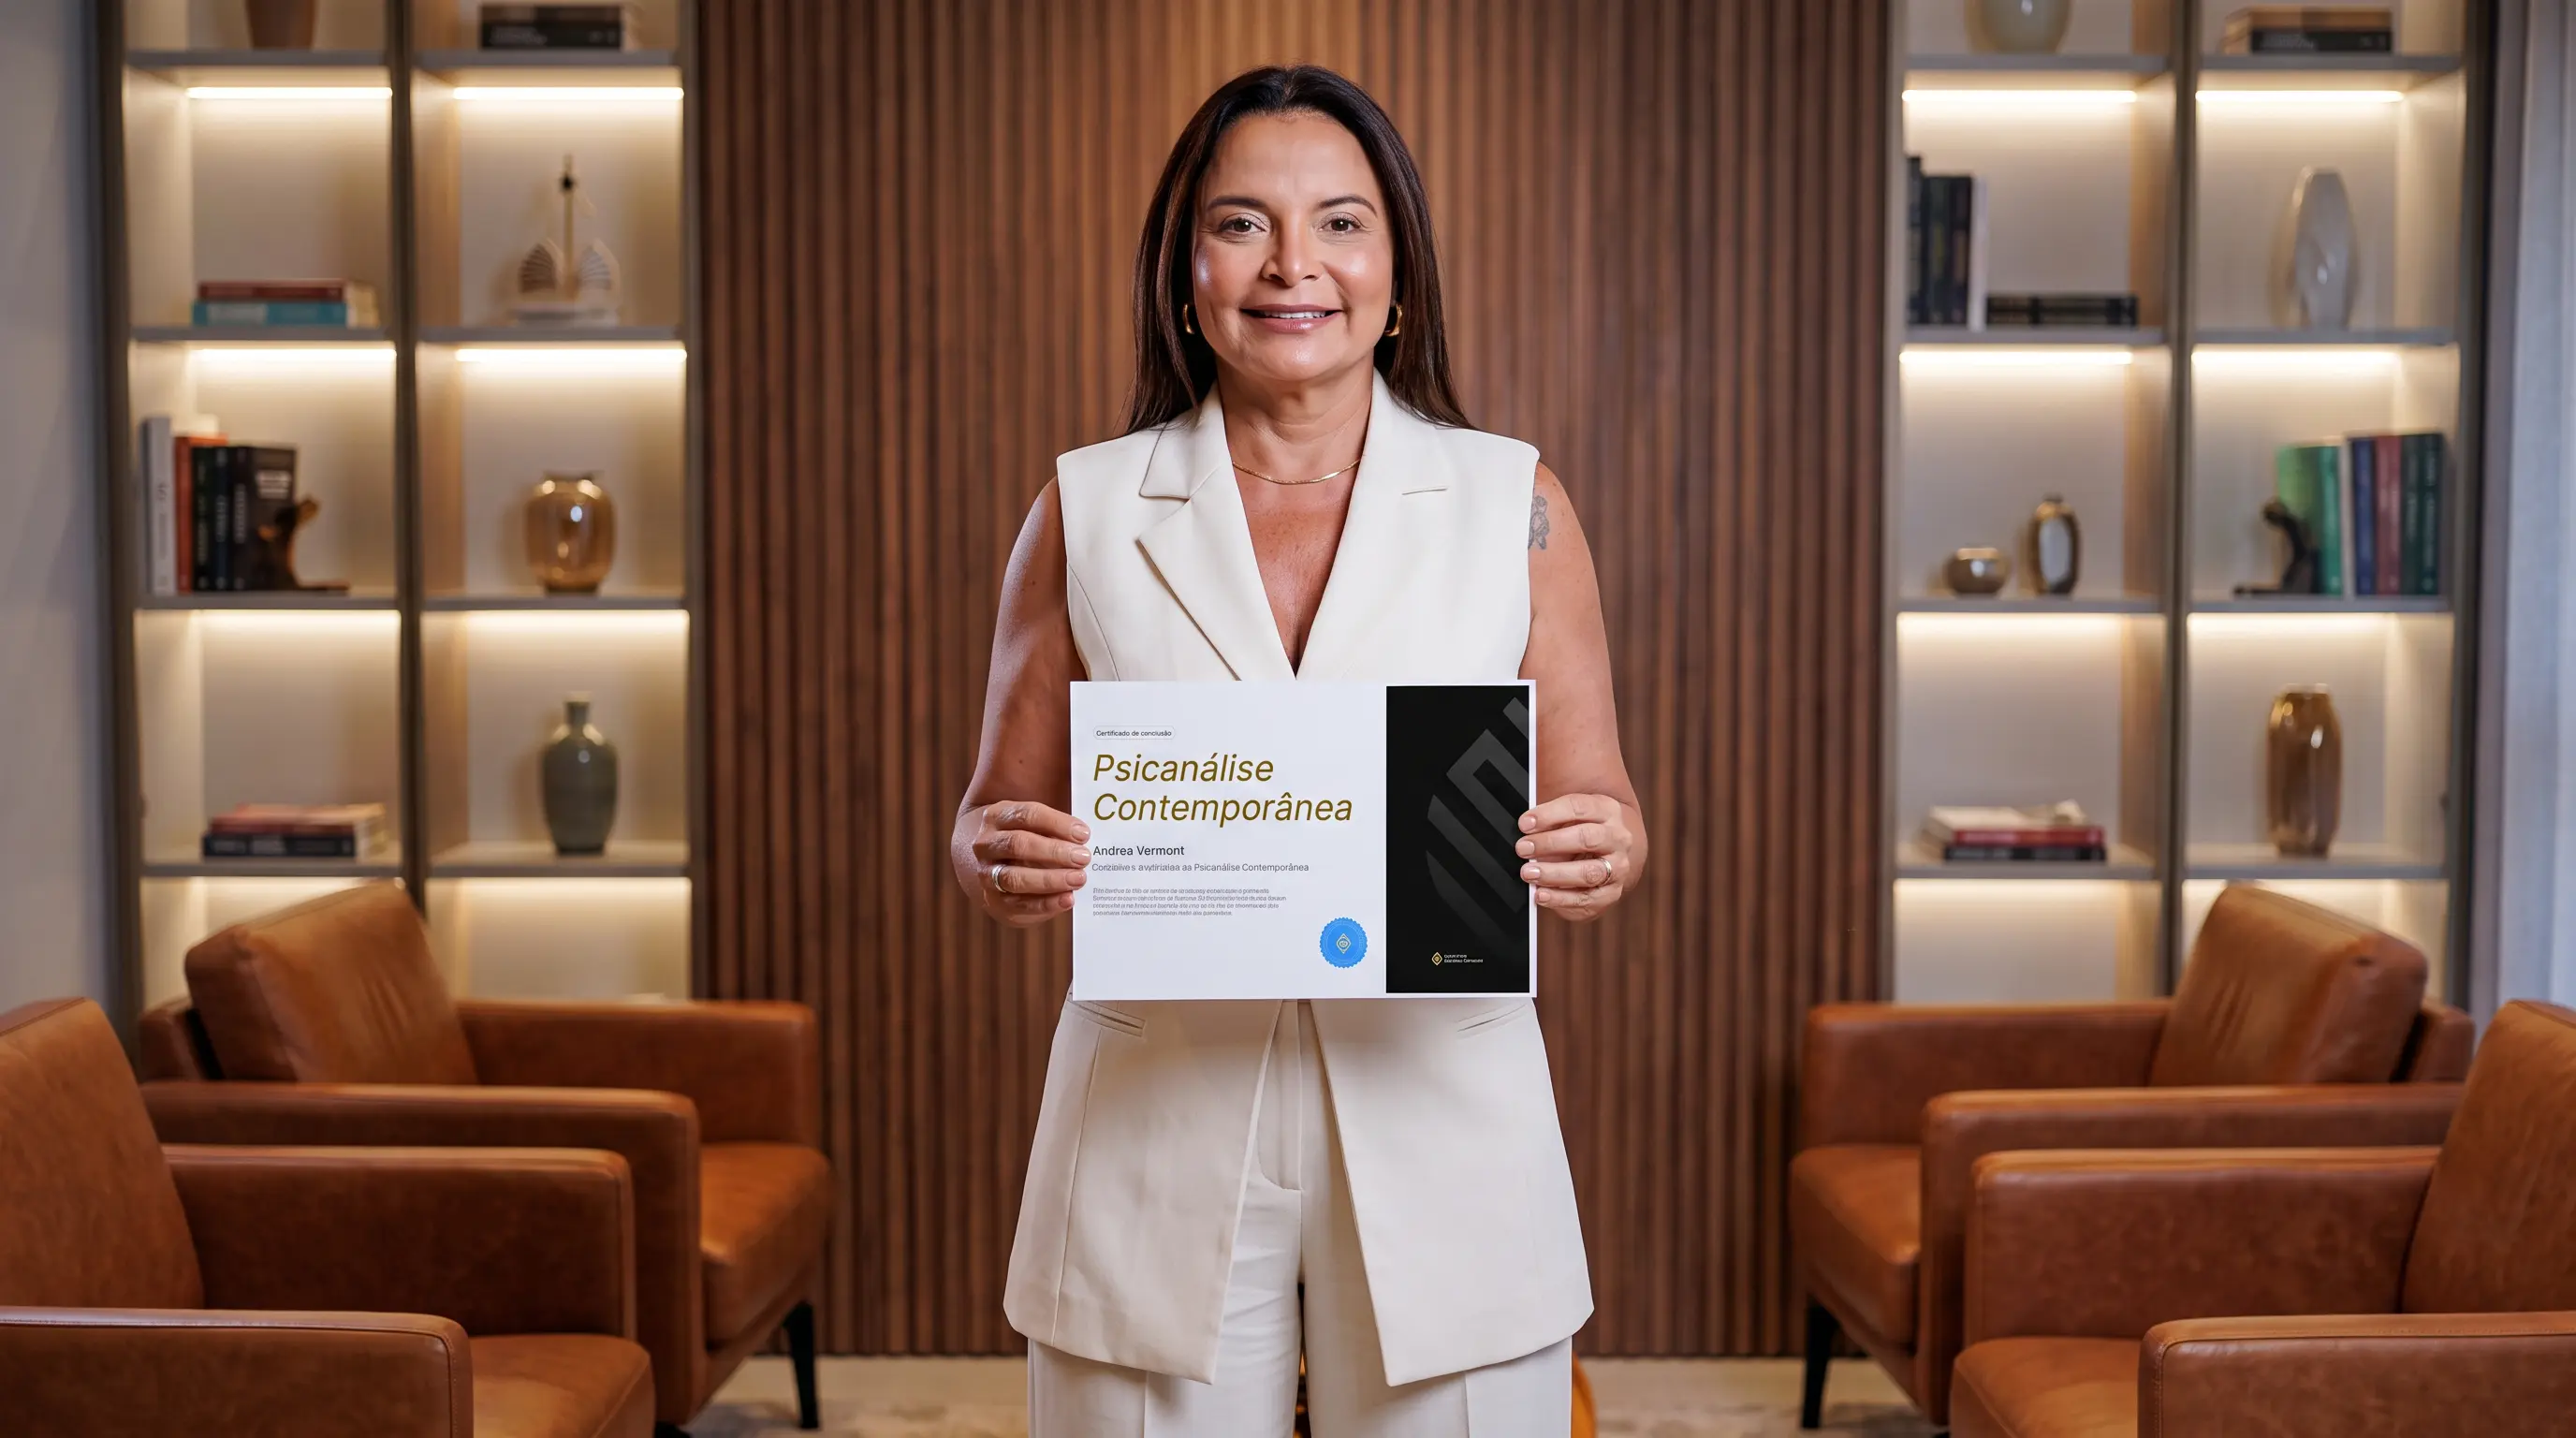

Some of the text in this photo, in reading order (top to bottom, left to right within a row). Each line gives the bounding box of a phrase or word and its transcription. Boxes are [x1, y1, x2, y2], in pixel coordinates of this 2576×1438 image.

[1093, 752, 1274, 782] Psicanálise
[1093, 791, 1353, 828] Contemporânea
[1092, 845, 1185, 856] Andrea Vermont
[1193, 863, 1240, 872] Psicanálise
[1241, 862, 1310, 873] Contemporânea
